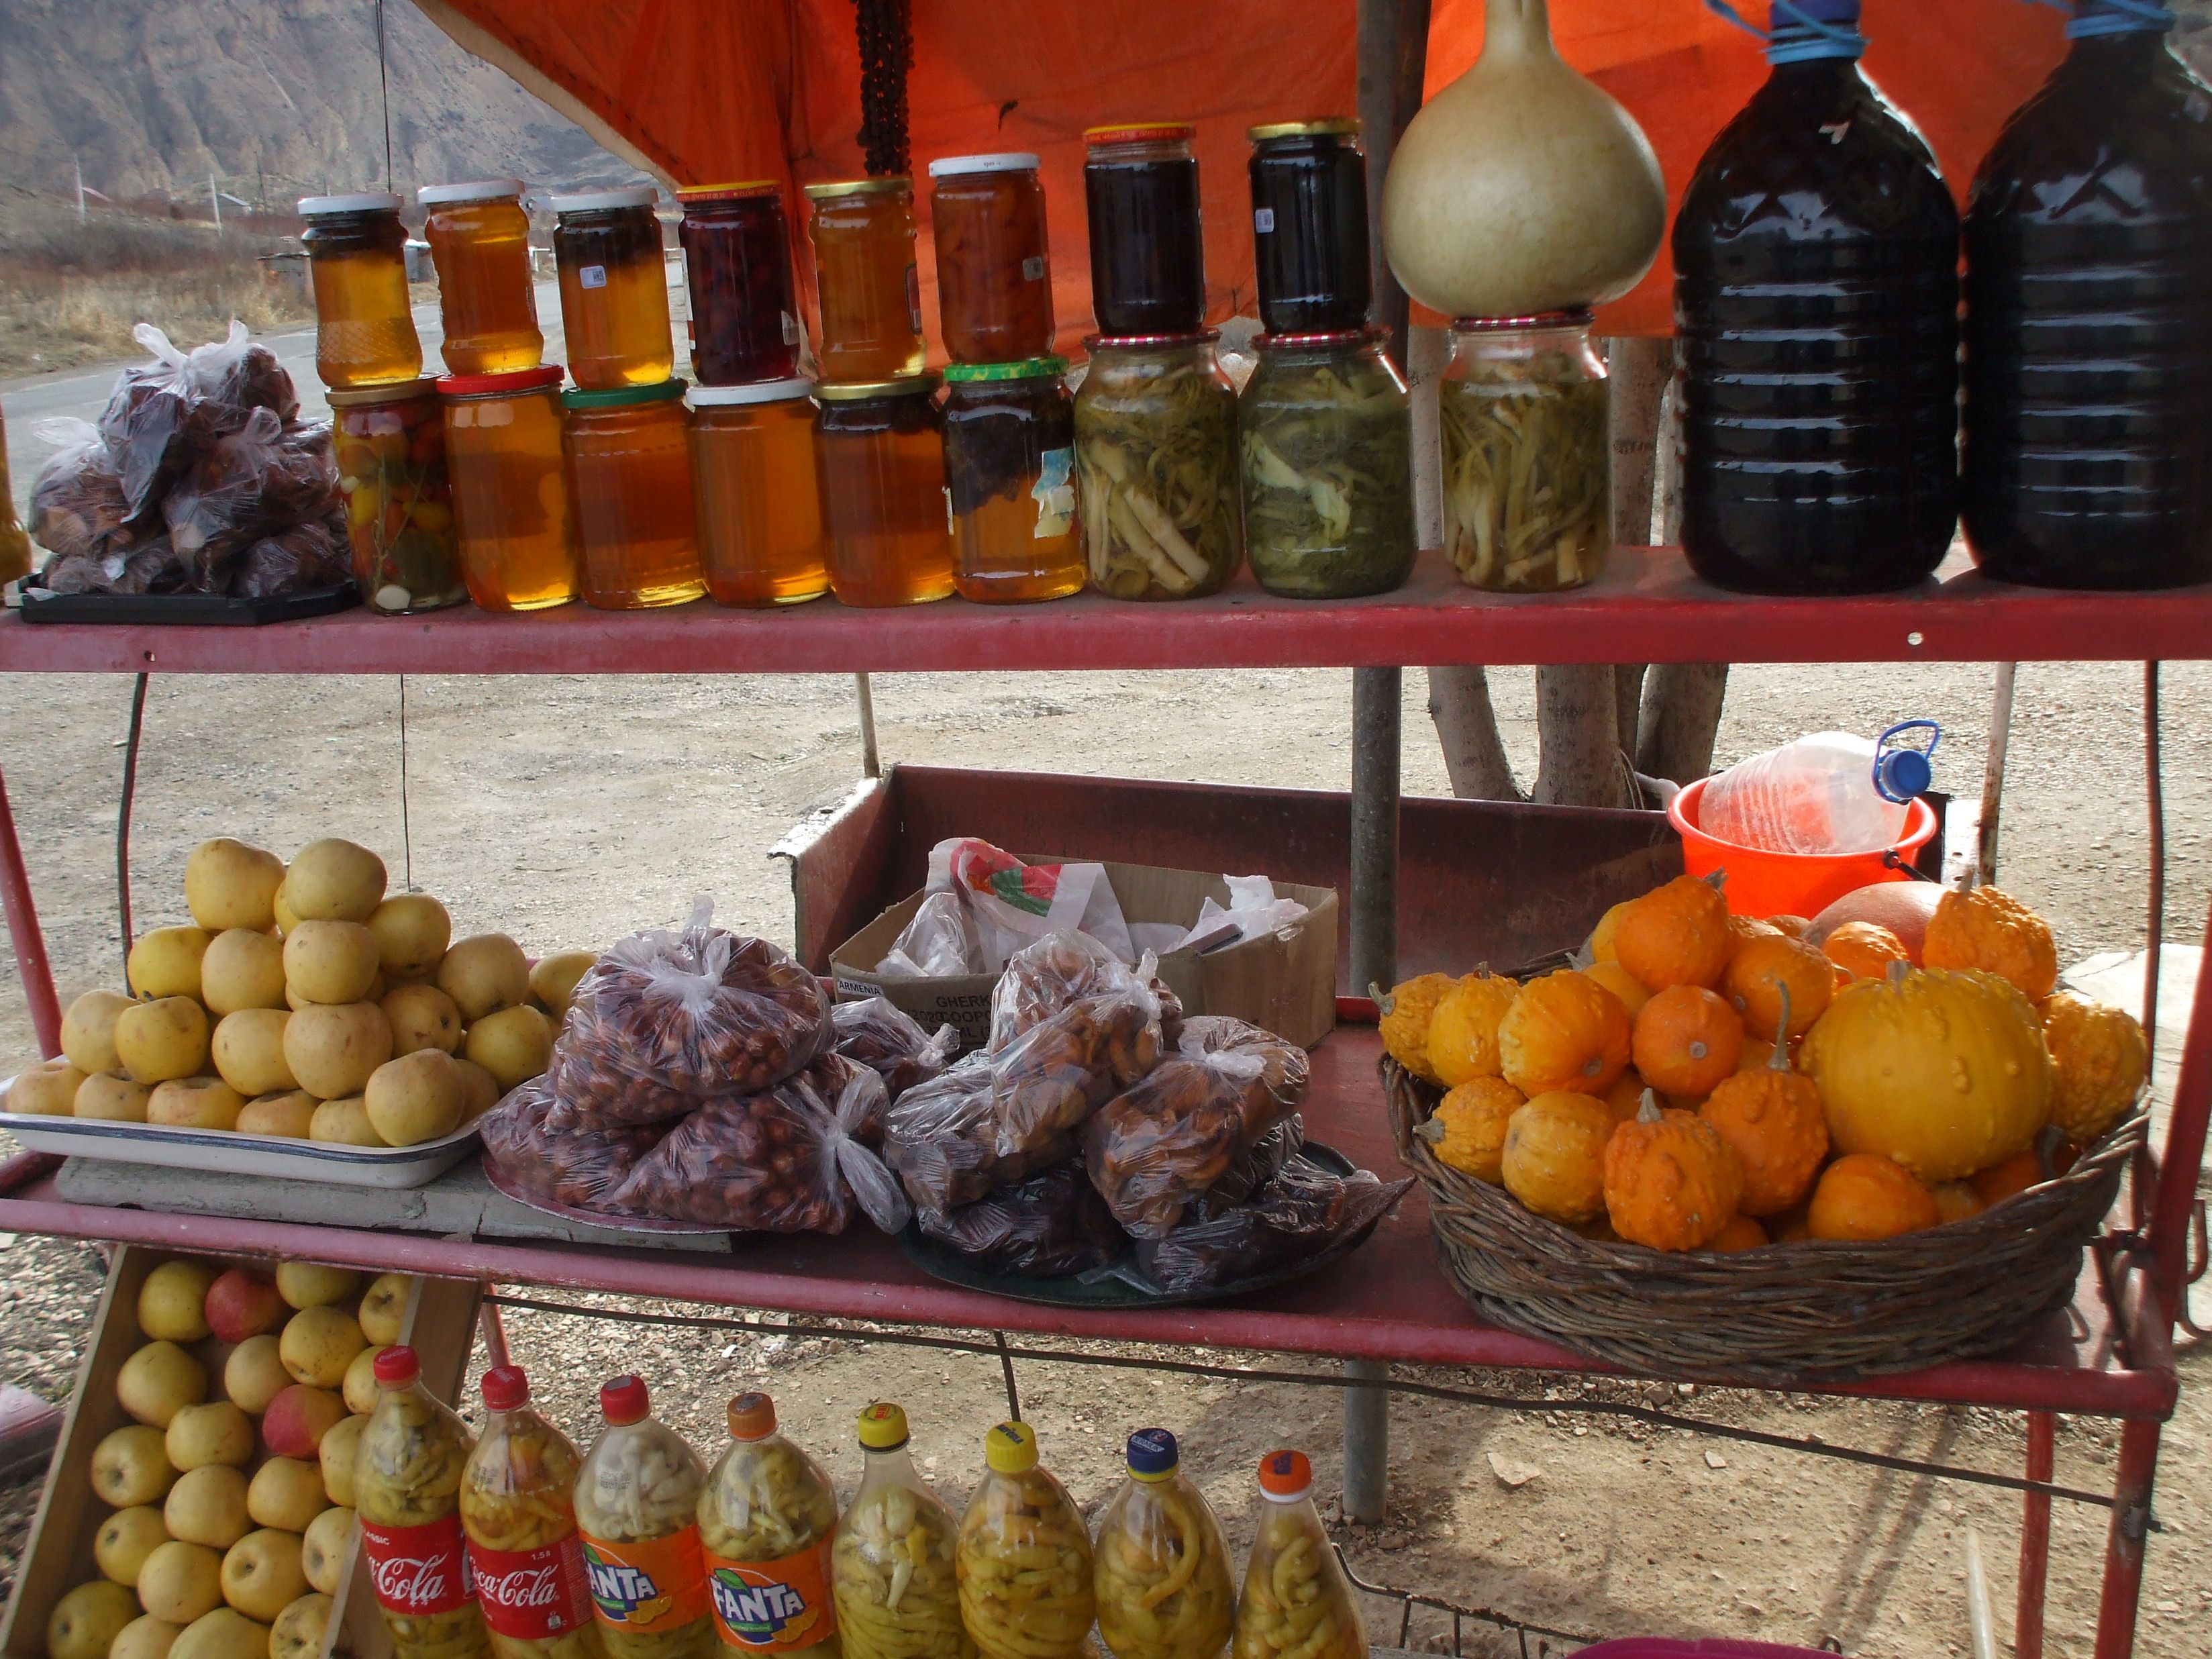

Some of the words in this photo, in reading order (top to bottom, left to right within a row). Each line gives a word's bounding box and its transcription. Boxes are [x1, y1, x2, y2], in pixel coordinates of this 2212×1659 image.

[839, 980, 881, 995] ARMENIA
[936, 995, 991, 1007] GHERK
[364, 1529, 390, 1546] ASSIC
[368, 1551, 448, 1607] a-Cola
[587, 1561, 656, 1600] ANTA
[710, 1576, 805, 1621] FANTA
